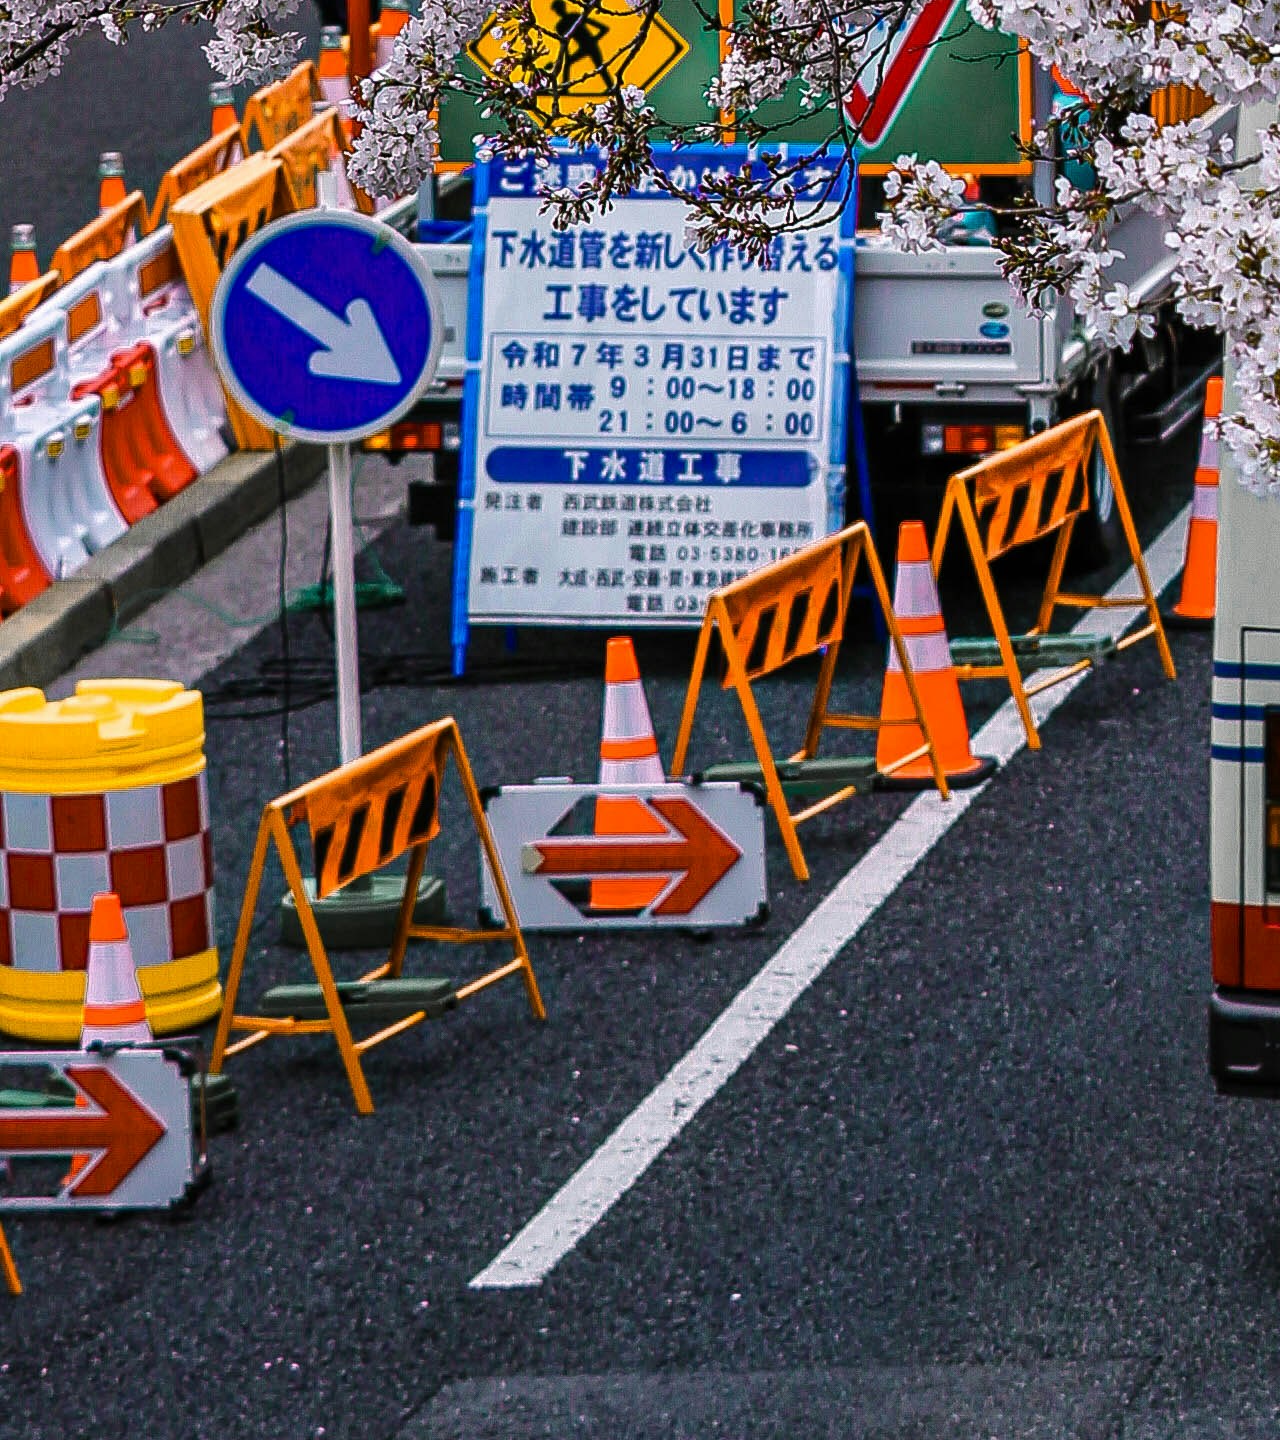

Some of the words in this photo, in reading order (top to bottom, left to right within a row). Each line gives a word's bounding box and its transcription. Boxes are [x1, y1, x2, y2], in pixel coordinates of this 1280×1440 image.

[543, 283, 789, 324] 工事をしています
[501, 382, 595, 413] 時間帯
[563, 450, 743, 484] 下水道工事
[485, 492, 542, 511] 発注者
[562, 492, 713, 514] 西武鉄道株式会社
